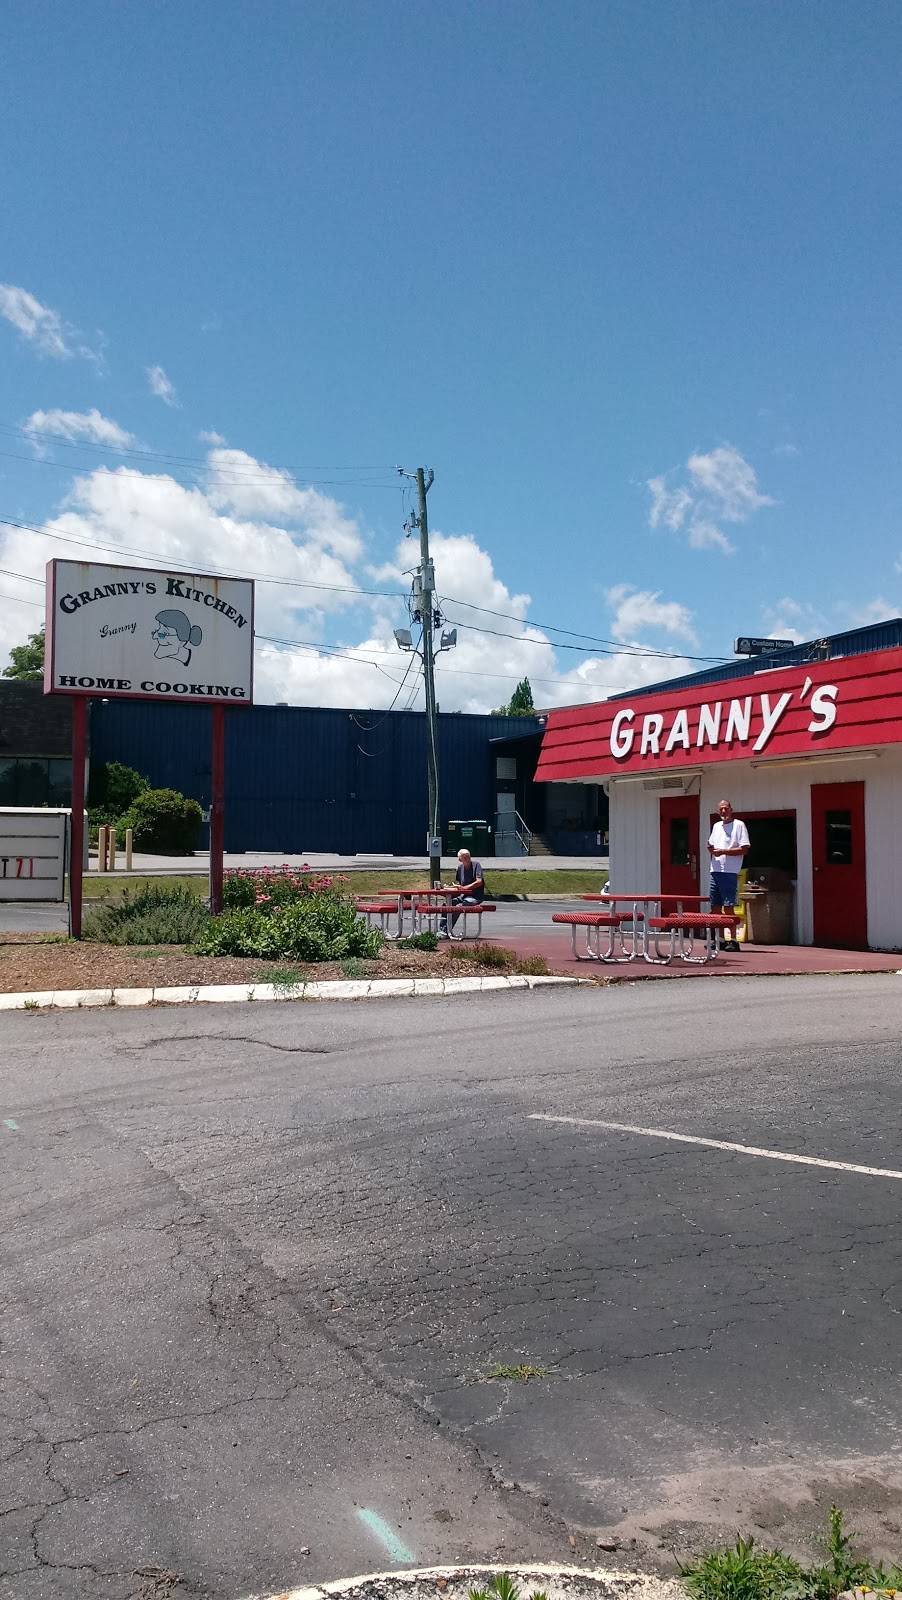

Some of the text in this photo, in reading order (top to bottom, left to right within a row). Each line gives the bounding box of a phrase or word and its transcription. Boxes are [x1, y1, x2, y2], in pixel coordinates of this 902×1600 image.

[59, 578, 248, 629] GRANNY'S KITCHEN
[99, 622, 137, 638] Granny
[59, 676, 246, 698] HOME COOKING
